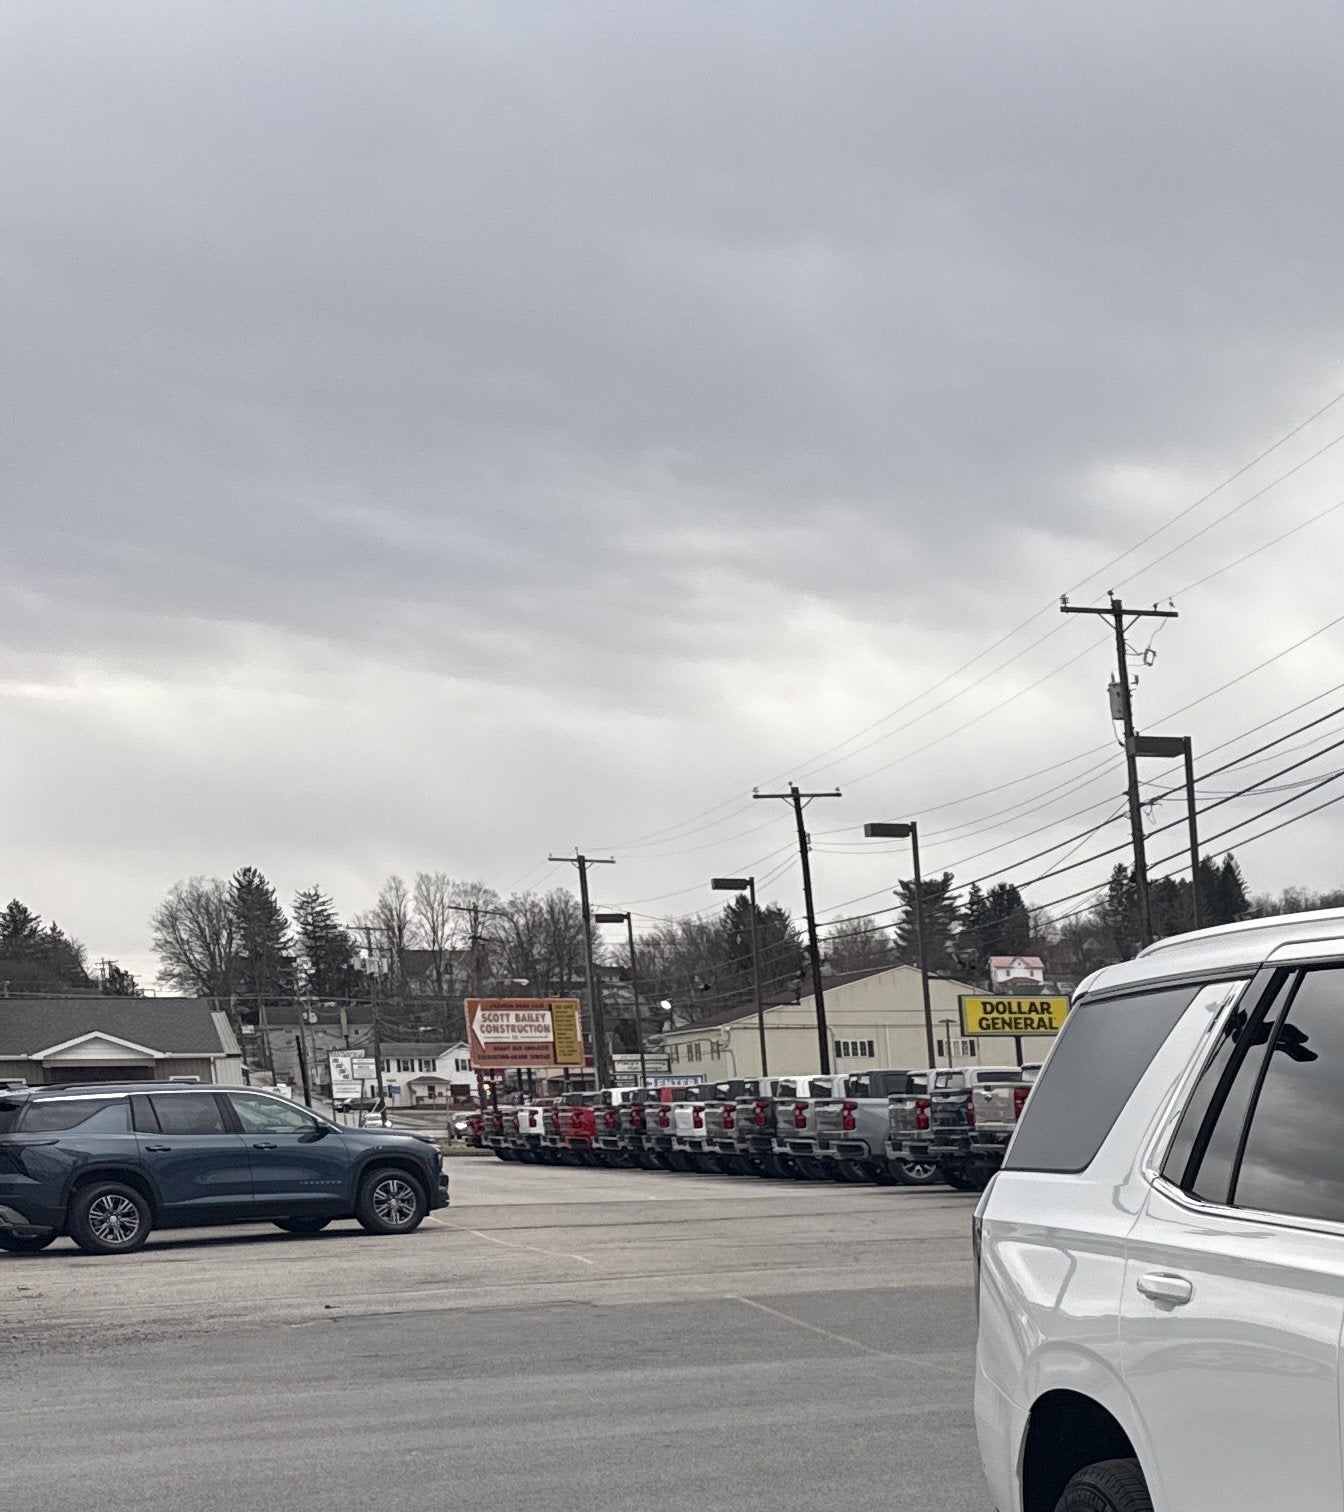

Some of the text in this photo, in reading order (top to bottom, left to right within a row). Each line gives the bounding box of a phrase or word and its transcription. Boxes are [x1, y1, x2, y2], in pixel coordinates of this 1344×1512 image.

[981, 1001, 1053, 1015] DOLLAR
[481, 1013, 546, 1023] SCOTT BAILEY
[978, 1017, 1058, 1031] GENERAL
[480, 1023, 550, 1034] CONSTRUCTION
